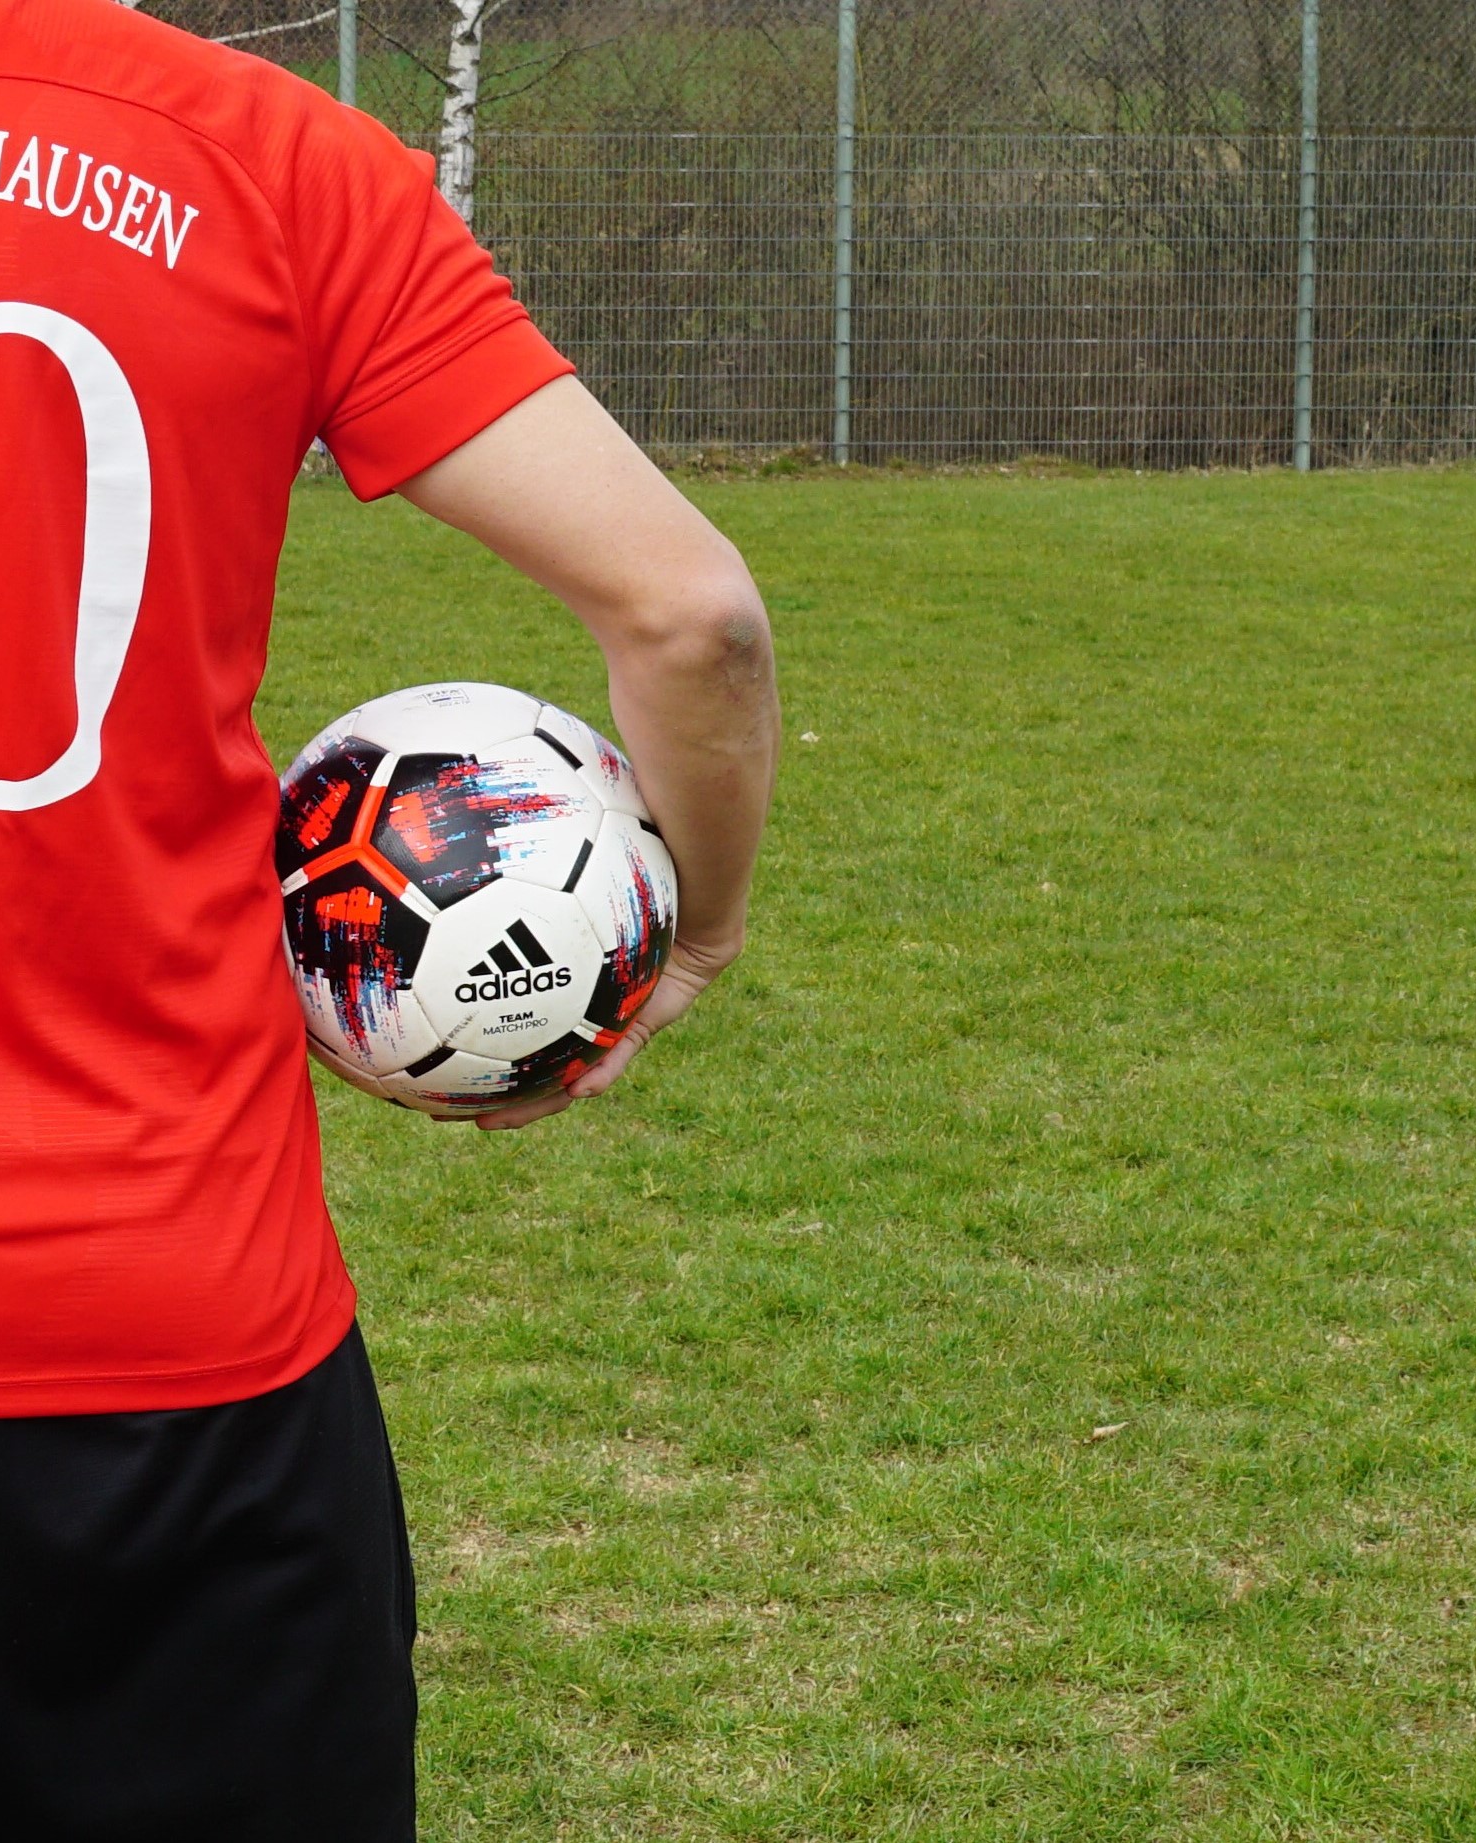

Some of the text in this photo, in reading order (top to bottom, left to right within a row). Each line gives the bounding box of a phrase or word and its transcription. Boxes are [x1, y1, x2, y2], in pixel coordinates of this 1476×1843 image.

[455, 967, 572, 1003] adidas
[499, 1011, 533, 1023] TEAM
[483, 1018, 548, 1035] MATCH PRO
